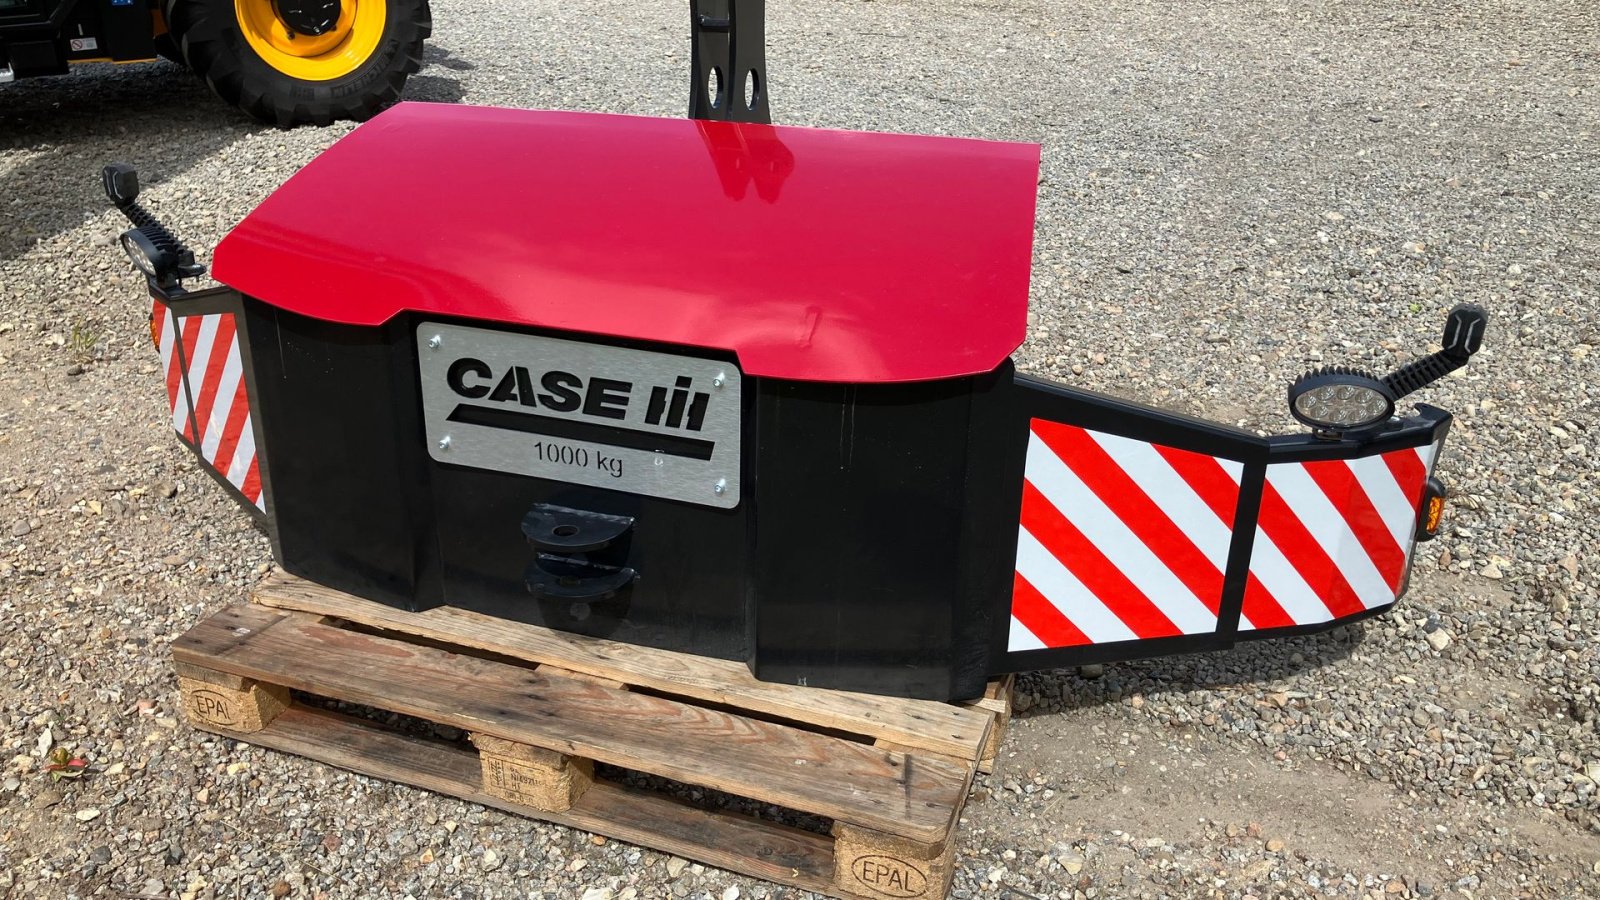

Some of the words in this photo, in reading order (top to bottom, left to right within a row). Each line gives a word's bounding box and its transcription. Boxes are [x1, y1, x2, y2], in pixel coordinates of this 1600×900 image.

[447, 358, 632, 420] CASE
[534, 442, 588, 467] 1000
[597, 451, 622, 477] kg
[863, 861, 915, 892] EPAL
